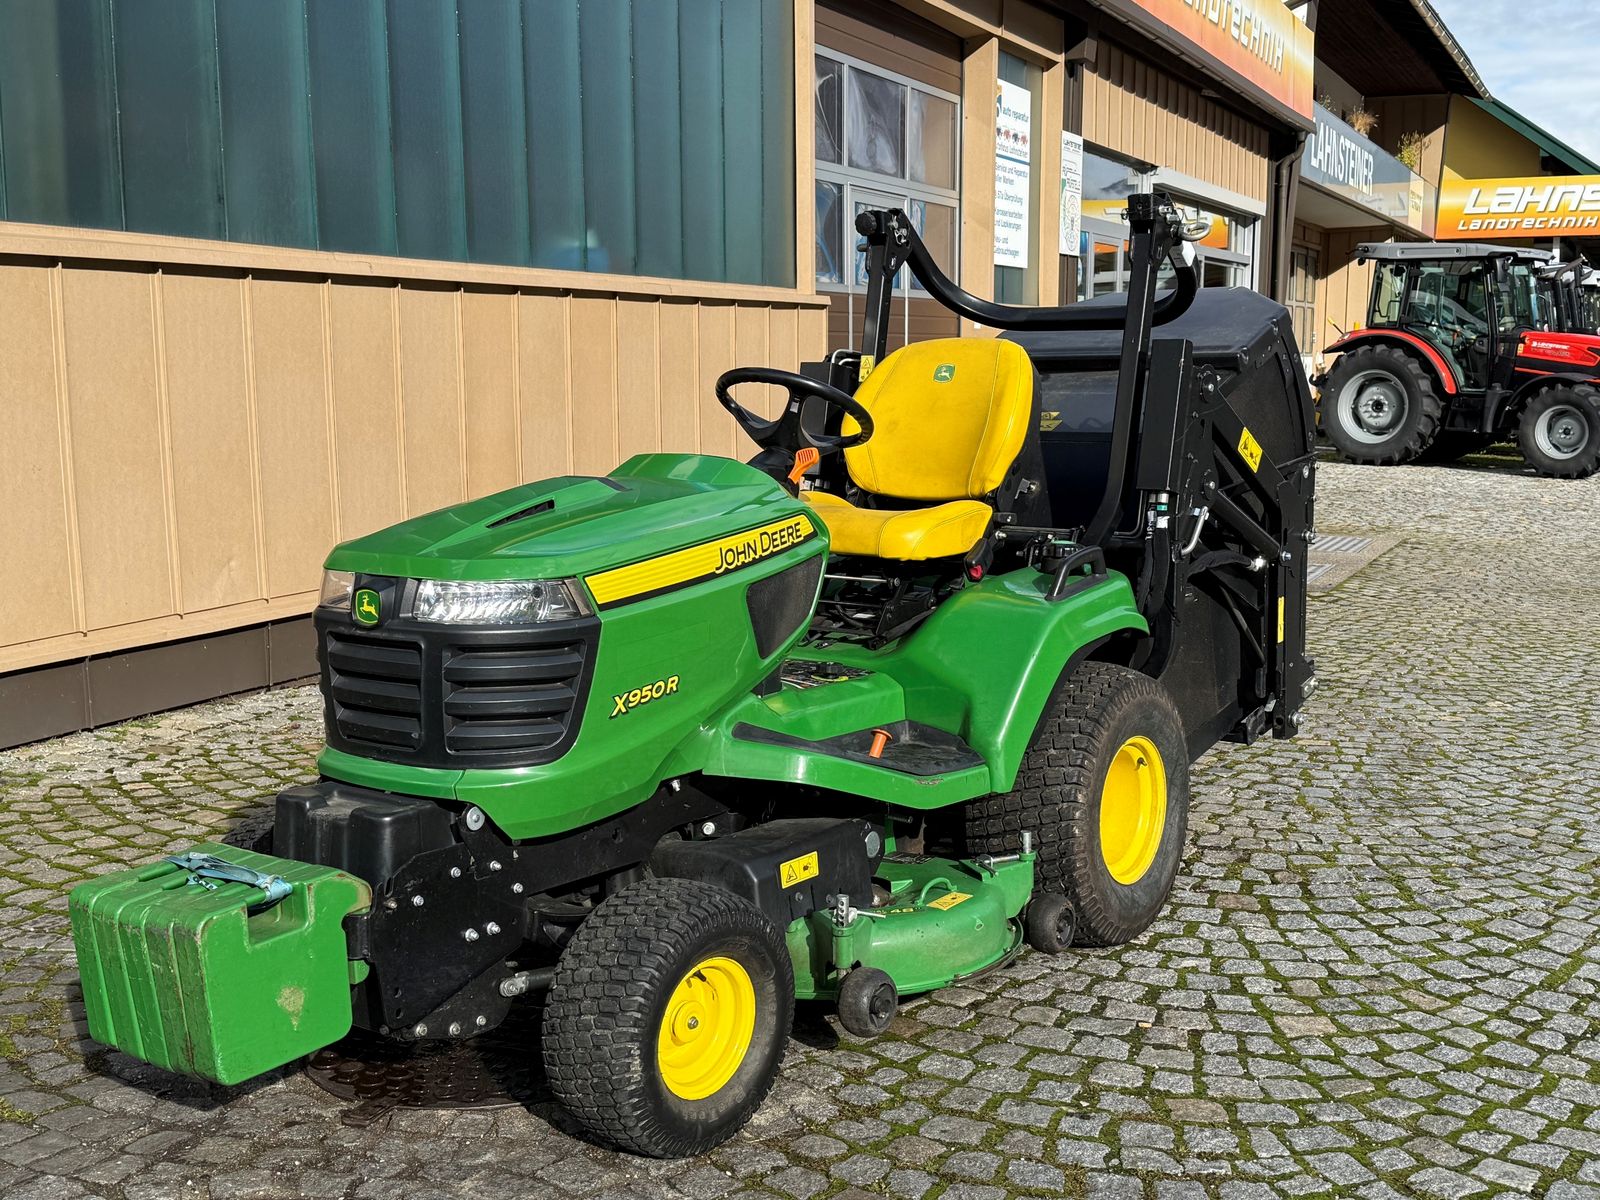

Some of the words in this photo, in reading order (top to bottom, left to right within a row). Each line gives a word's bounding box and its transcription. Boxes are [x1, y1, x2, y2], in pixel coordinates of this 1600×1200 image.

[1184, 0, 1285, 73] DTECHNIK
[1311, 117, 1374, 197] LAHNSTEINER
[1457, 216, 1599, 231] LANDTECHNIK
[715, 540, 758, 572] JOHN
[760, 521, 803, 555] DEERE
